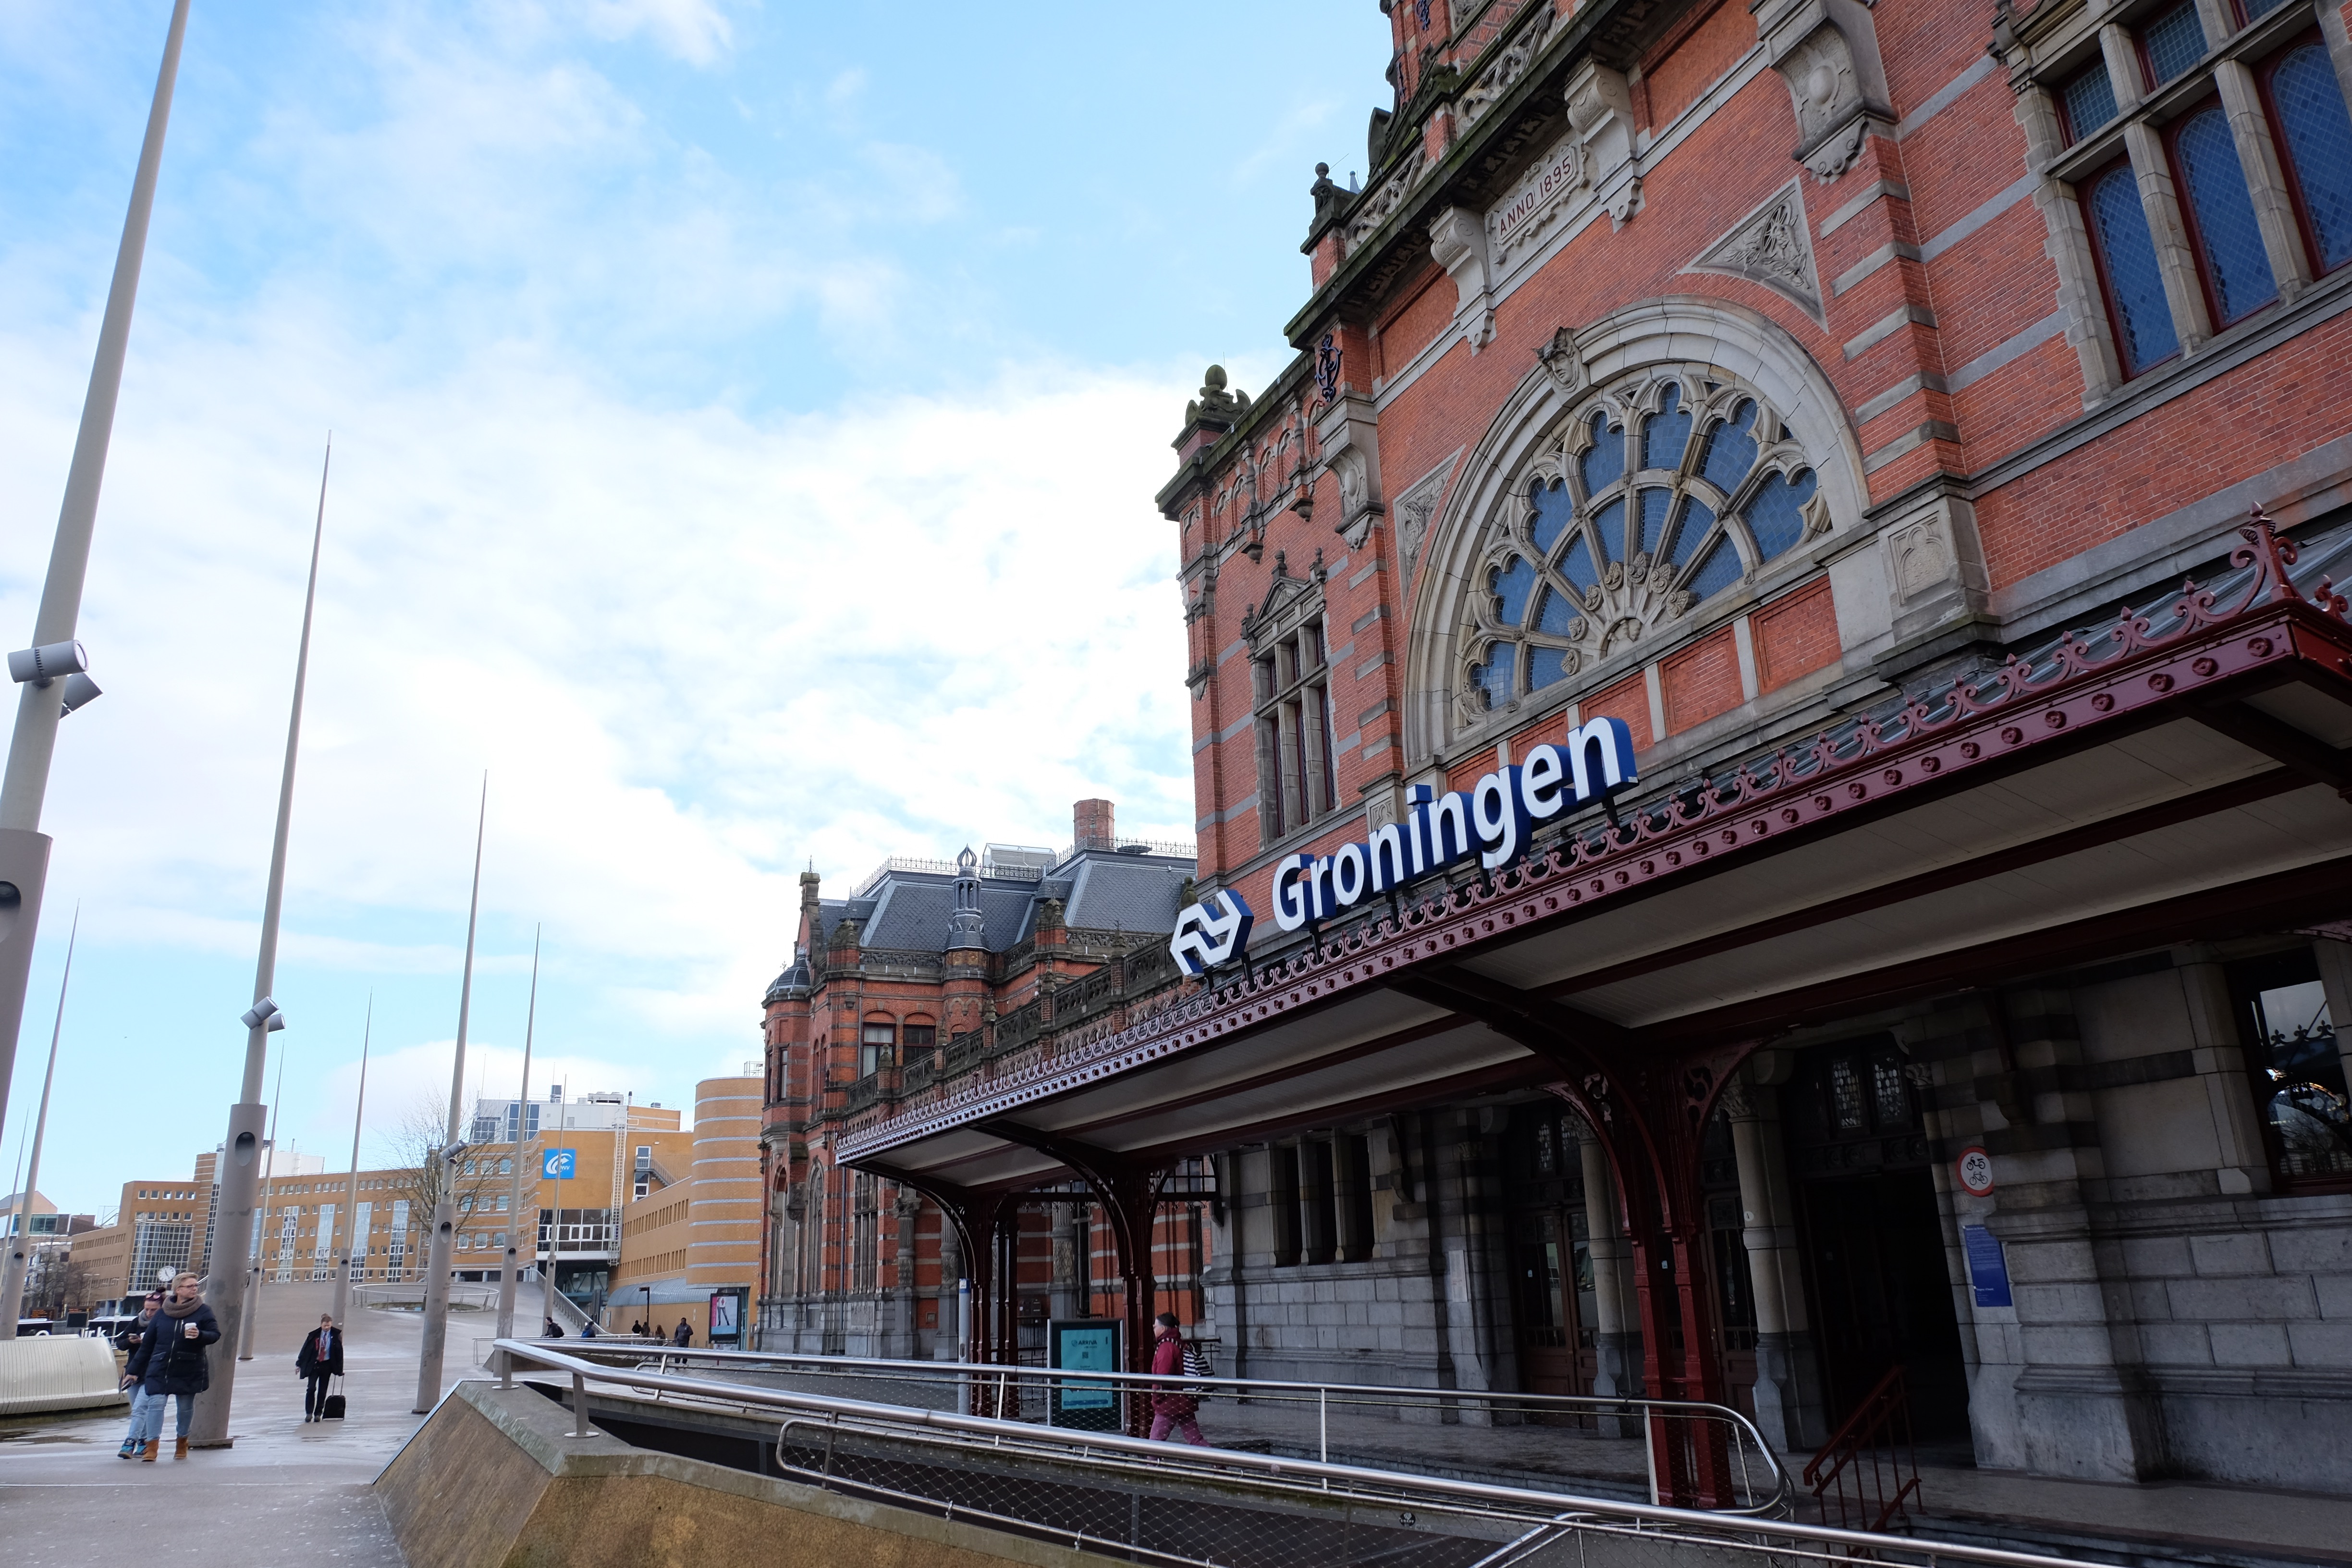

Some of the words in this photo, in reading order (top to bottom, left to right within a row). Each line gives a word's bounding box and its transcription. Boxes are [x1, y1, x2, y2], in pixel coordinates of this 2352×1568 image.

[1500, 192, 1534, 235] ANNO
[1540, 155, 1571, 198] 1895
[1272, 716, 1632, 931] Groningen
